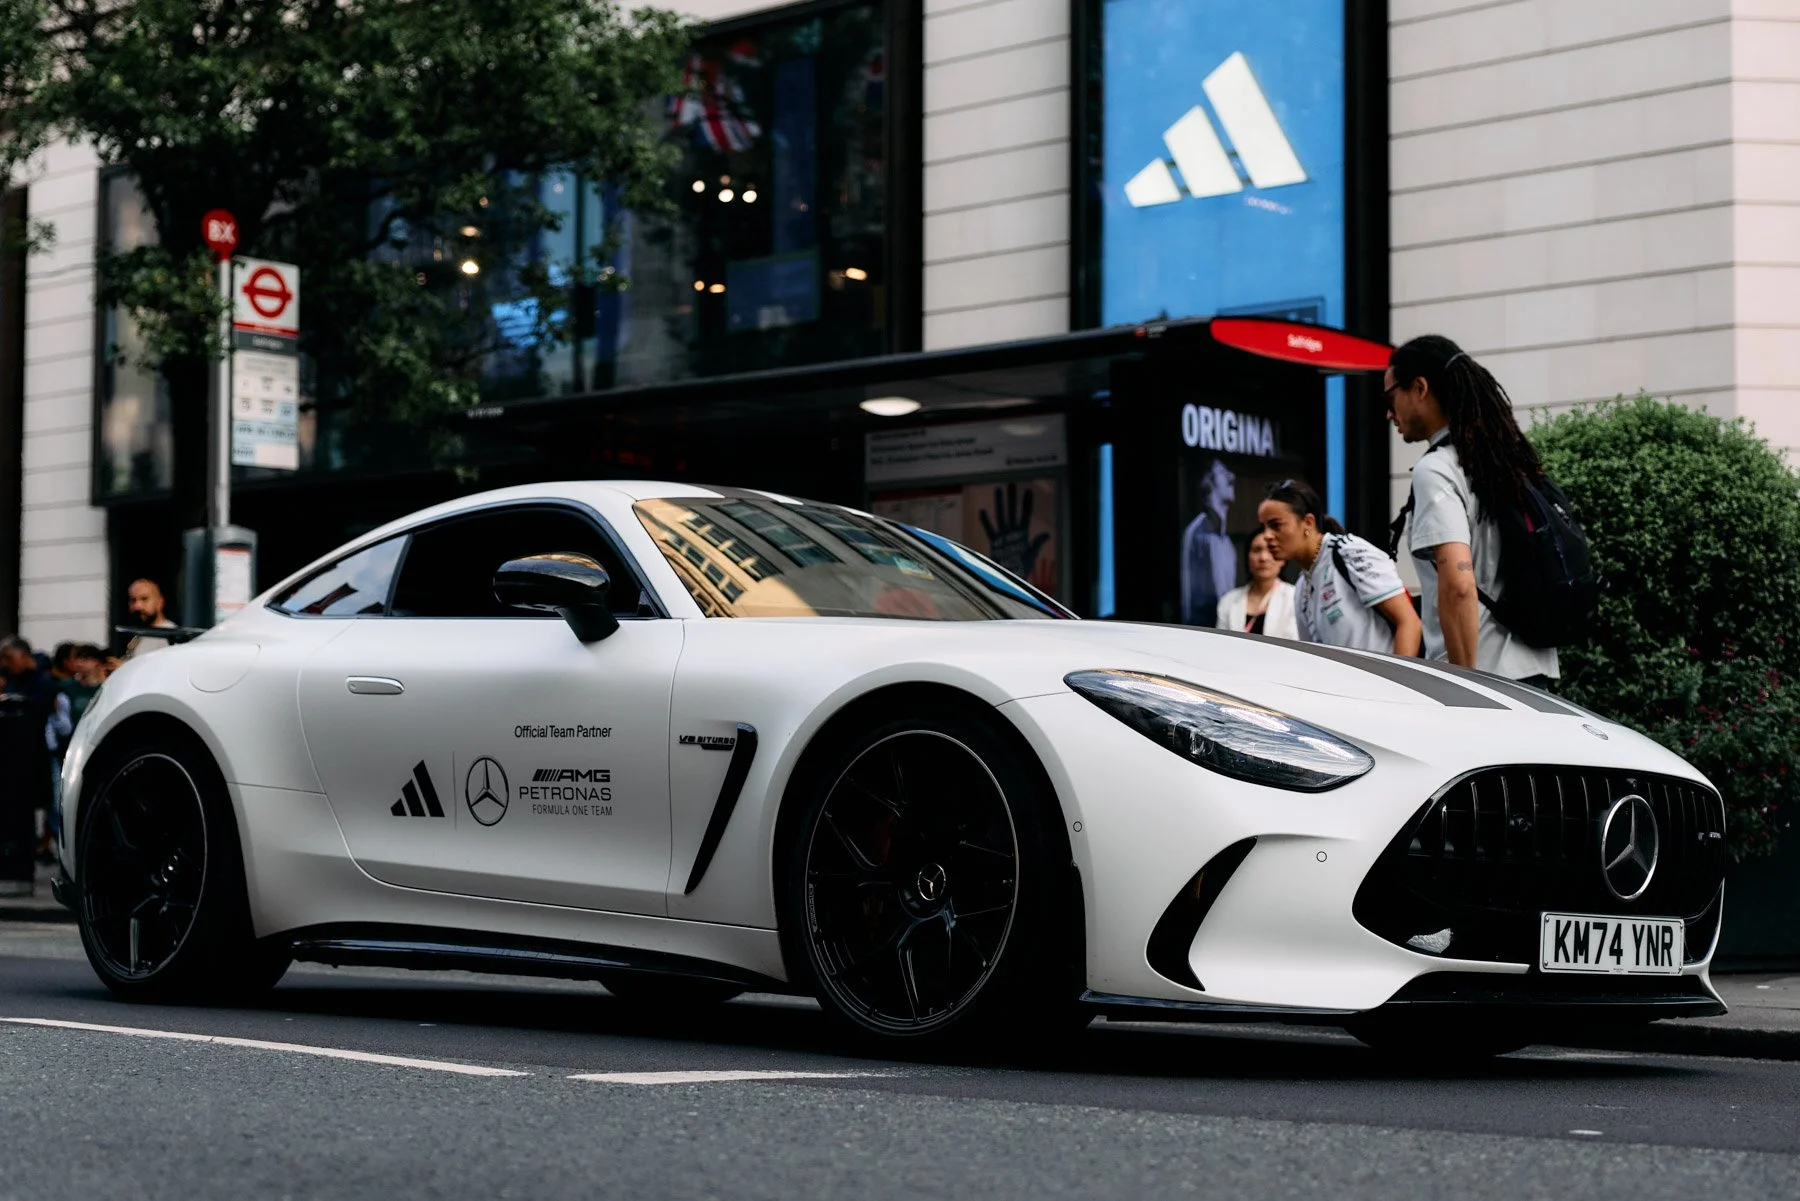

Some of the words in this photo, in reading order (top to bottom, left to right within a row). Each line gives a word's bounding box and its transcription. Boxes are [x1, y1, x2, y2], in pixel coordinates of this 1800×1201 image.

[208, 219, 236, 244] BX
[1181, 403, 1277, 458] ORIGINA
[514, 725, 548, 738] Official
[549, 725, 575, 738] Team
[576, 725, 612, 738] Partner
[679, 734, 696, 744] V8
[697, 735, 736, 745] BITURBO
[557, 769, 611, 783] AMG
[518, 786, 612, 801] PETRONAS
[532, 804, 570, 815] FORMULA
[572, 805, 589, 816] ONE
[590, 805, 613, 816] TEAM
[1554, 919, 1623, 965] KM74
[1632, 924, 1674, 967] YNR
